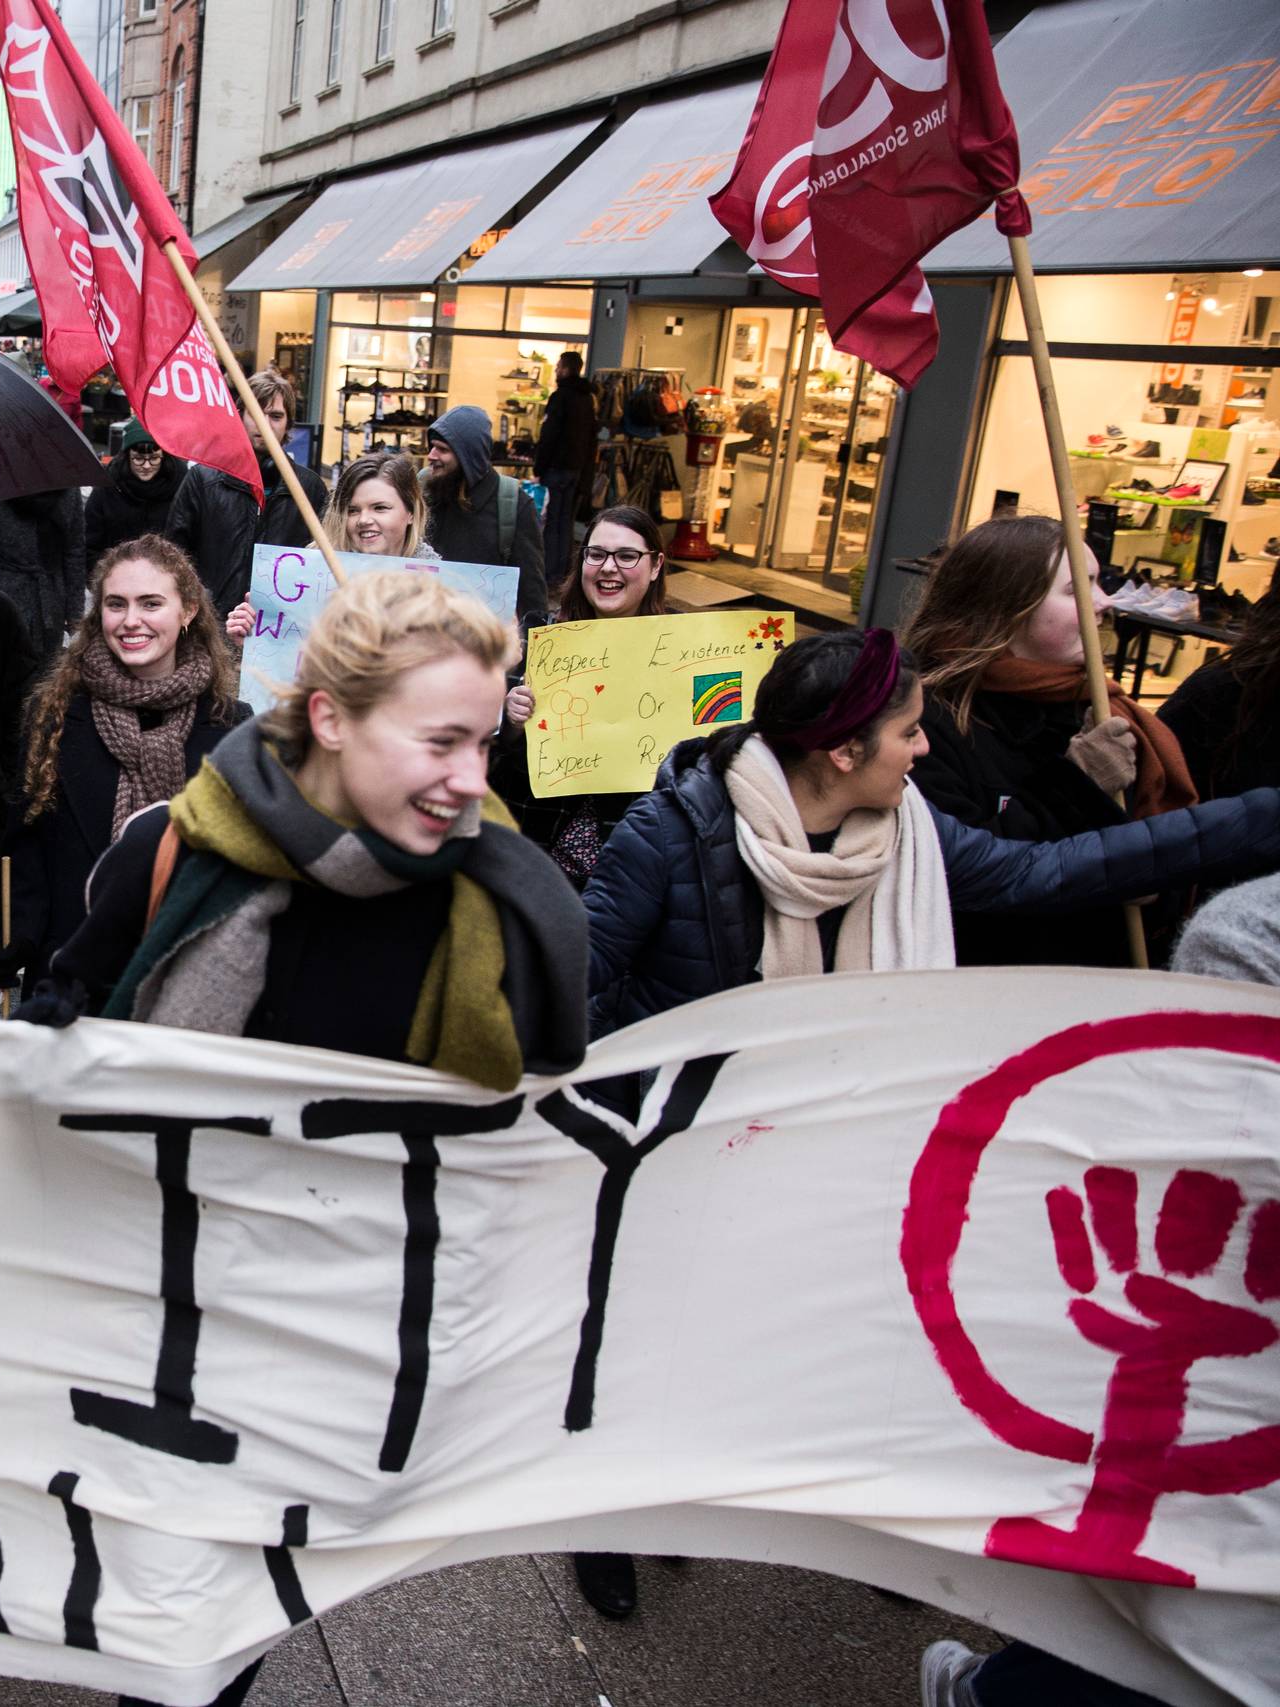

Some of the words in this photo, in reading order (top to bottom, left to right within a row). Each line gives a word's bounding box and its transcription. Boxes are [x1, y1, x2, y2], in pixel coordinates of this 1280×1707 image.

[255, 609, 304, 639] WA
[536, 639, 610, 682] Respect
[648, 633, 746, 667] Existence
[638, 692, 665, 719] Or
[538, 738, 602, 779] Expect
[638, 735, 665, 765] Re
